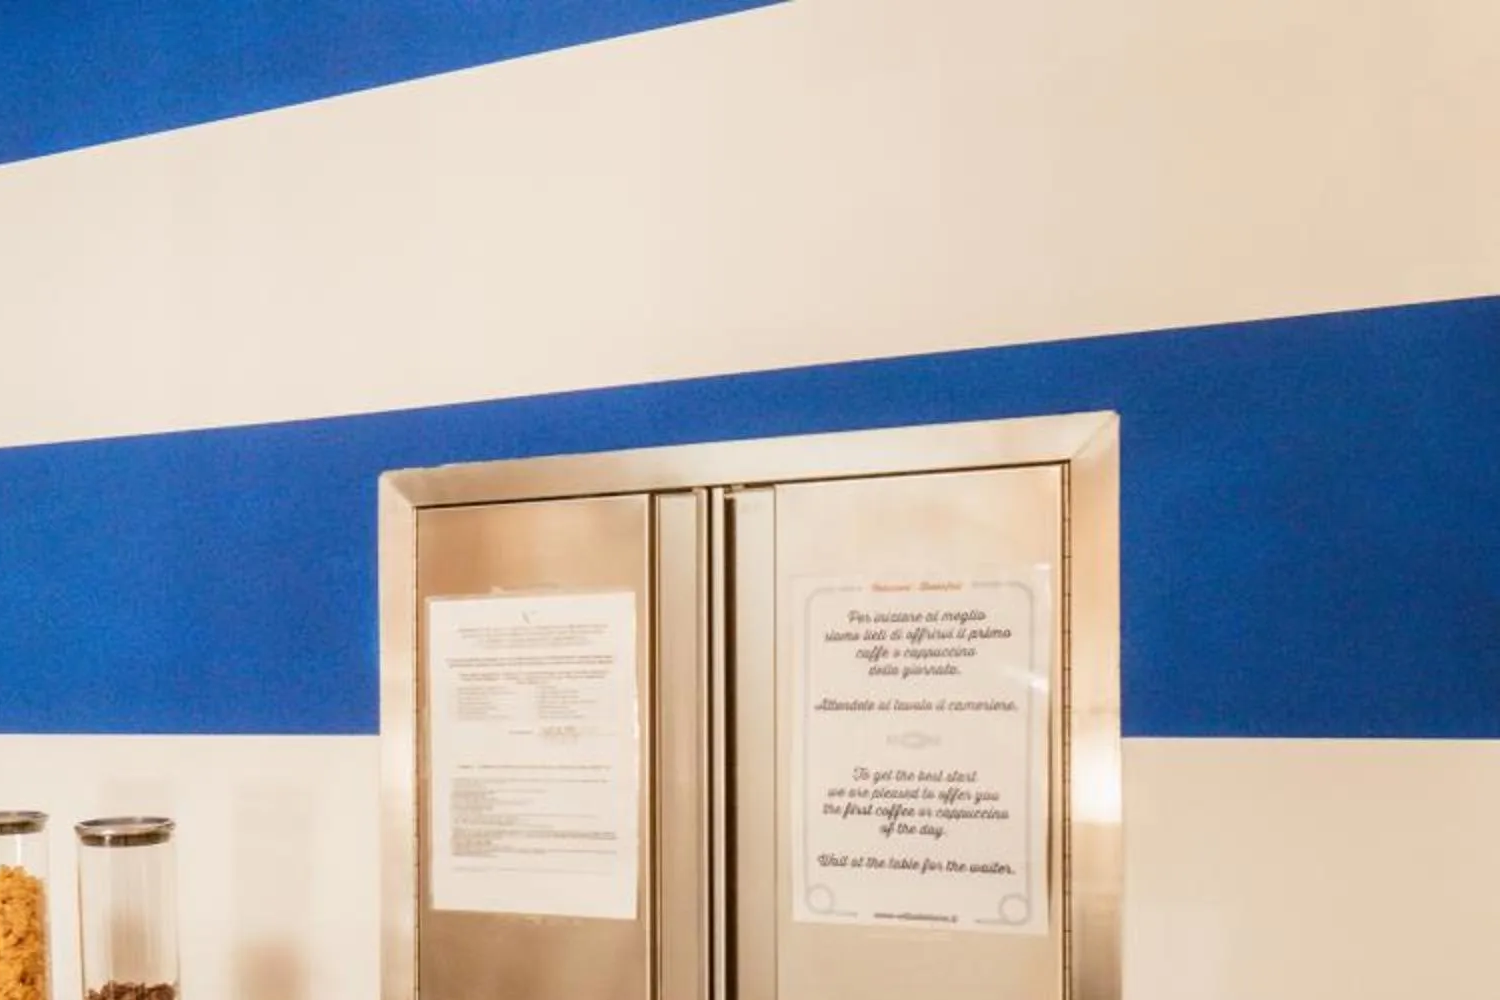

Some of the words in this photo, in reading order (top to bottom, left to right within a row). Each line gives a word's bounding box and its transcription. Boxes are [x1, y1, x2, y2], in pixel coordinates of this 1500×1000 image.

[847, 609, 872, 623] Per
[874, 609, 922, 623] iniziare
[925, 610, 940, 623] al
[941, 609, 987, 625] meglio
[824, 629, 860, 642] siamo
[863, 627, 887, 641] lieti
[890, 627, 902, 641] di
[956, 627, 966, 640] il
[967, 626, 1012, 642] primo
[903, 647, 977, 660] cappuccino
[868, 664, 899, 677] della
[814, 697, 875, 711] Attendete
[878, 698, 892, 711] al
[894, 698, 933, 711] tavolo
[852, 766, 870, 782] To
[873, 769, 893, 785] get
[896, 769, 915, 782] the
[918, 769, 943, 783] best
[946, 770, 978, 783] start
[827, 788, 846, 798] we
[848, 788, 869, 798] are
[870, 787, 920, 801] pleased
[921, 787, 936, 800] to
[938, 786, 971, 806] offer
[973, 791, 1000, 806] you
[822, 802, 841, 815] the
[842, 801, 873, 820] first
[875, 803, 915, 821] coffee
[917, 807, 932, 818] or
[935, 806, 1009, 821] cappuccino
[879, 821, 895, 839] of
[897, 822, 917, 835] the
[817, 852, 848, 868] Wait
[850, 856, 864, 869] at
[865, 857, 885, 870] the
[887, 857, 920, 871] table
[921, 858, 943, 875] for
[945, 860, 967, 873] the
[969, 861, 1016, 876] waiter.
